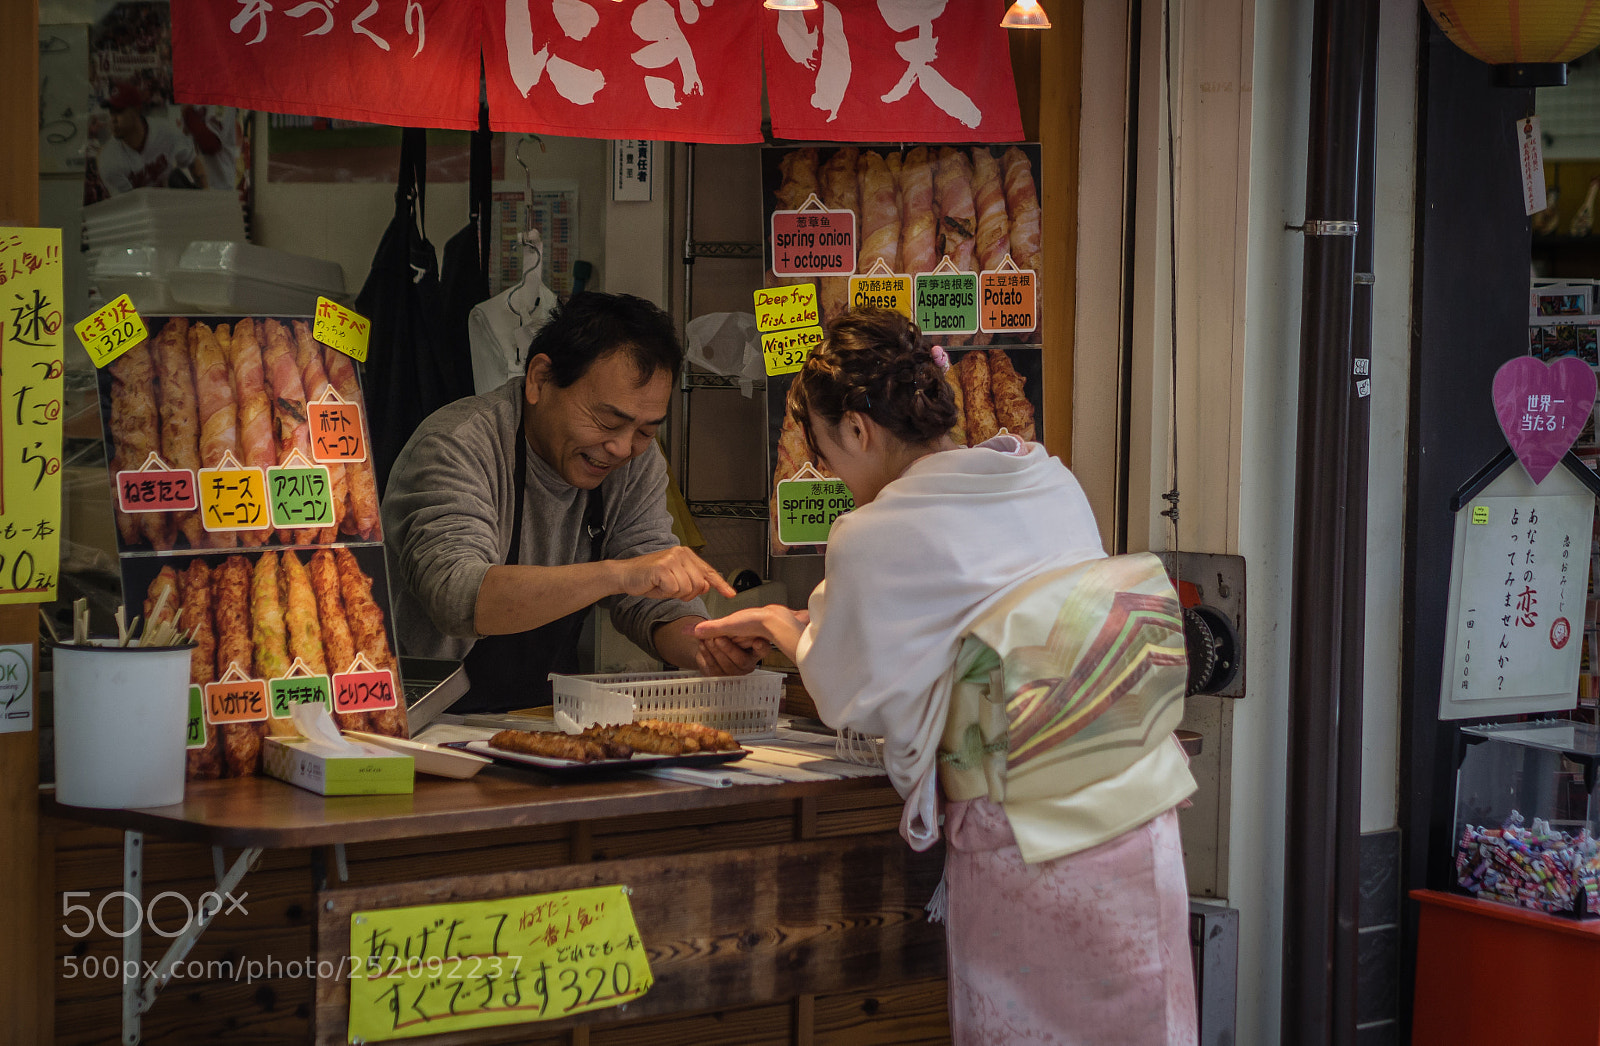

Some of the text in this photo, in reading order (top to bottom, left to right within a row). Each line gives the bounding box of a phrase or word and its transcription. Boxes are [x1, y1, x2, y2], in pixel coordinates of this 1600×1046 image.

[777, 229, 851, 248] spring onion
[781, 251, 842, 270] + octopus
[858, 280, 904, 292] 奶酪培根
[985, 276, 1030, 287] 土豆培根
[756, 288, 813, 307] Deep fry
[855, 292, 897, 308] Cheese
[918, 290, 974, 309] Asparagus
[984, 288, 1022, 306] Potato
[81, 298, 137, 342] にぎり天
[760, 310, 816, 328] Fish cake
[923, 312, 965, 329] + bacon
[989, 310, 1031, 327] + bacon
[764, 333, 822, 355] Nigiriten
[1528, 394, 1565, 412] 世界一
[1521, 413, 1565, 431] 当たる！
[317, 436, 359, 456] ベーコン
[125, 479, 190, 503] ねぎたこ
[212, 476, 253, 500] チーズ
[277, 500, 327, 521] ベーコン
[783, 496, 823, 511] spring
[209, 503, 261, 524] ベーコン
[787, 512, 797, 524] +
[801, 511, 824, 525] red
[0, 519, 54, 540] も一本
[1515, 508, 1538, 628] あなたの恋
[338, 683, 391, 705] とりつくね
[364, 913, 508, 973] あげたて
[374, 960, 552, 1031] すぐできます
